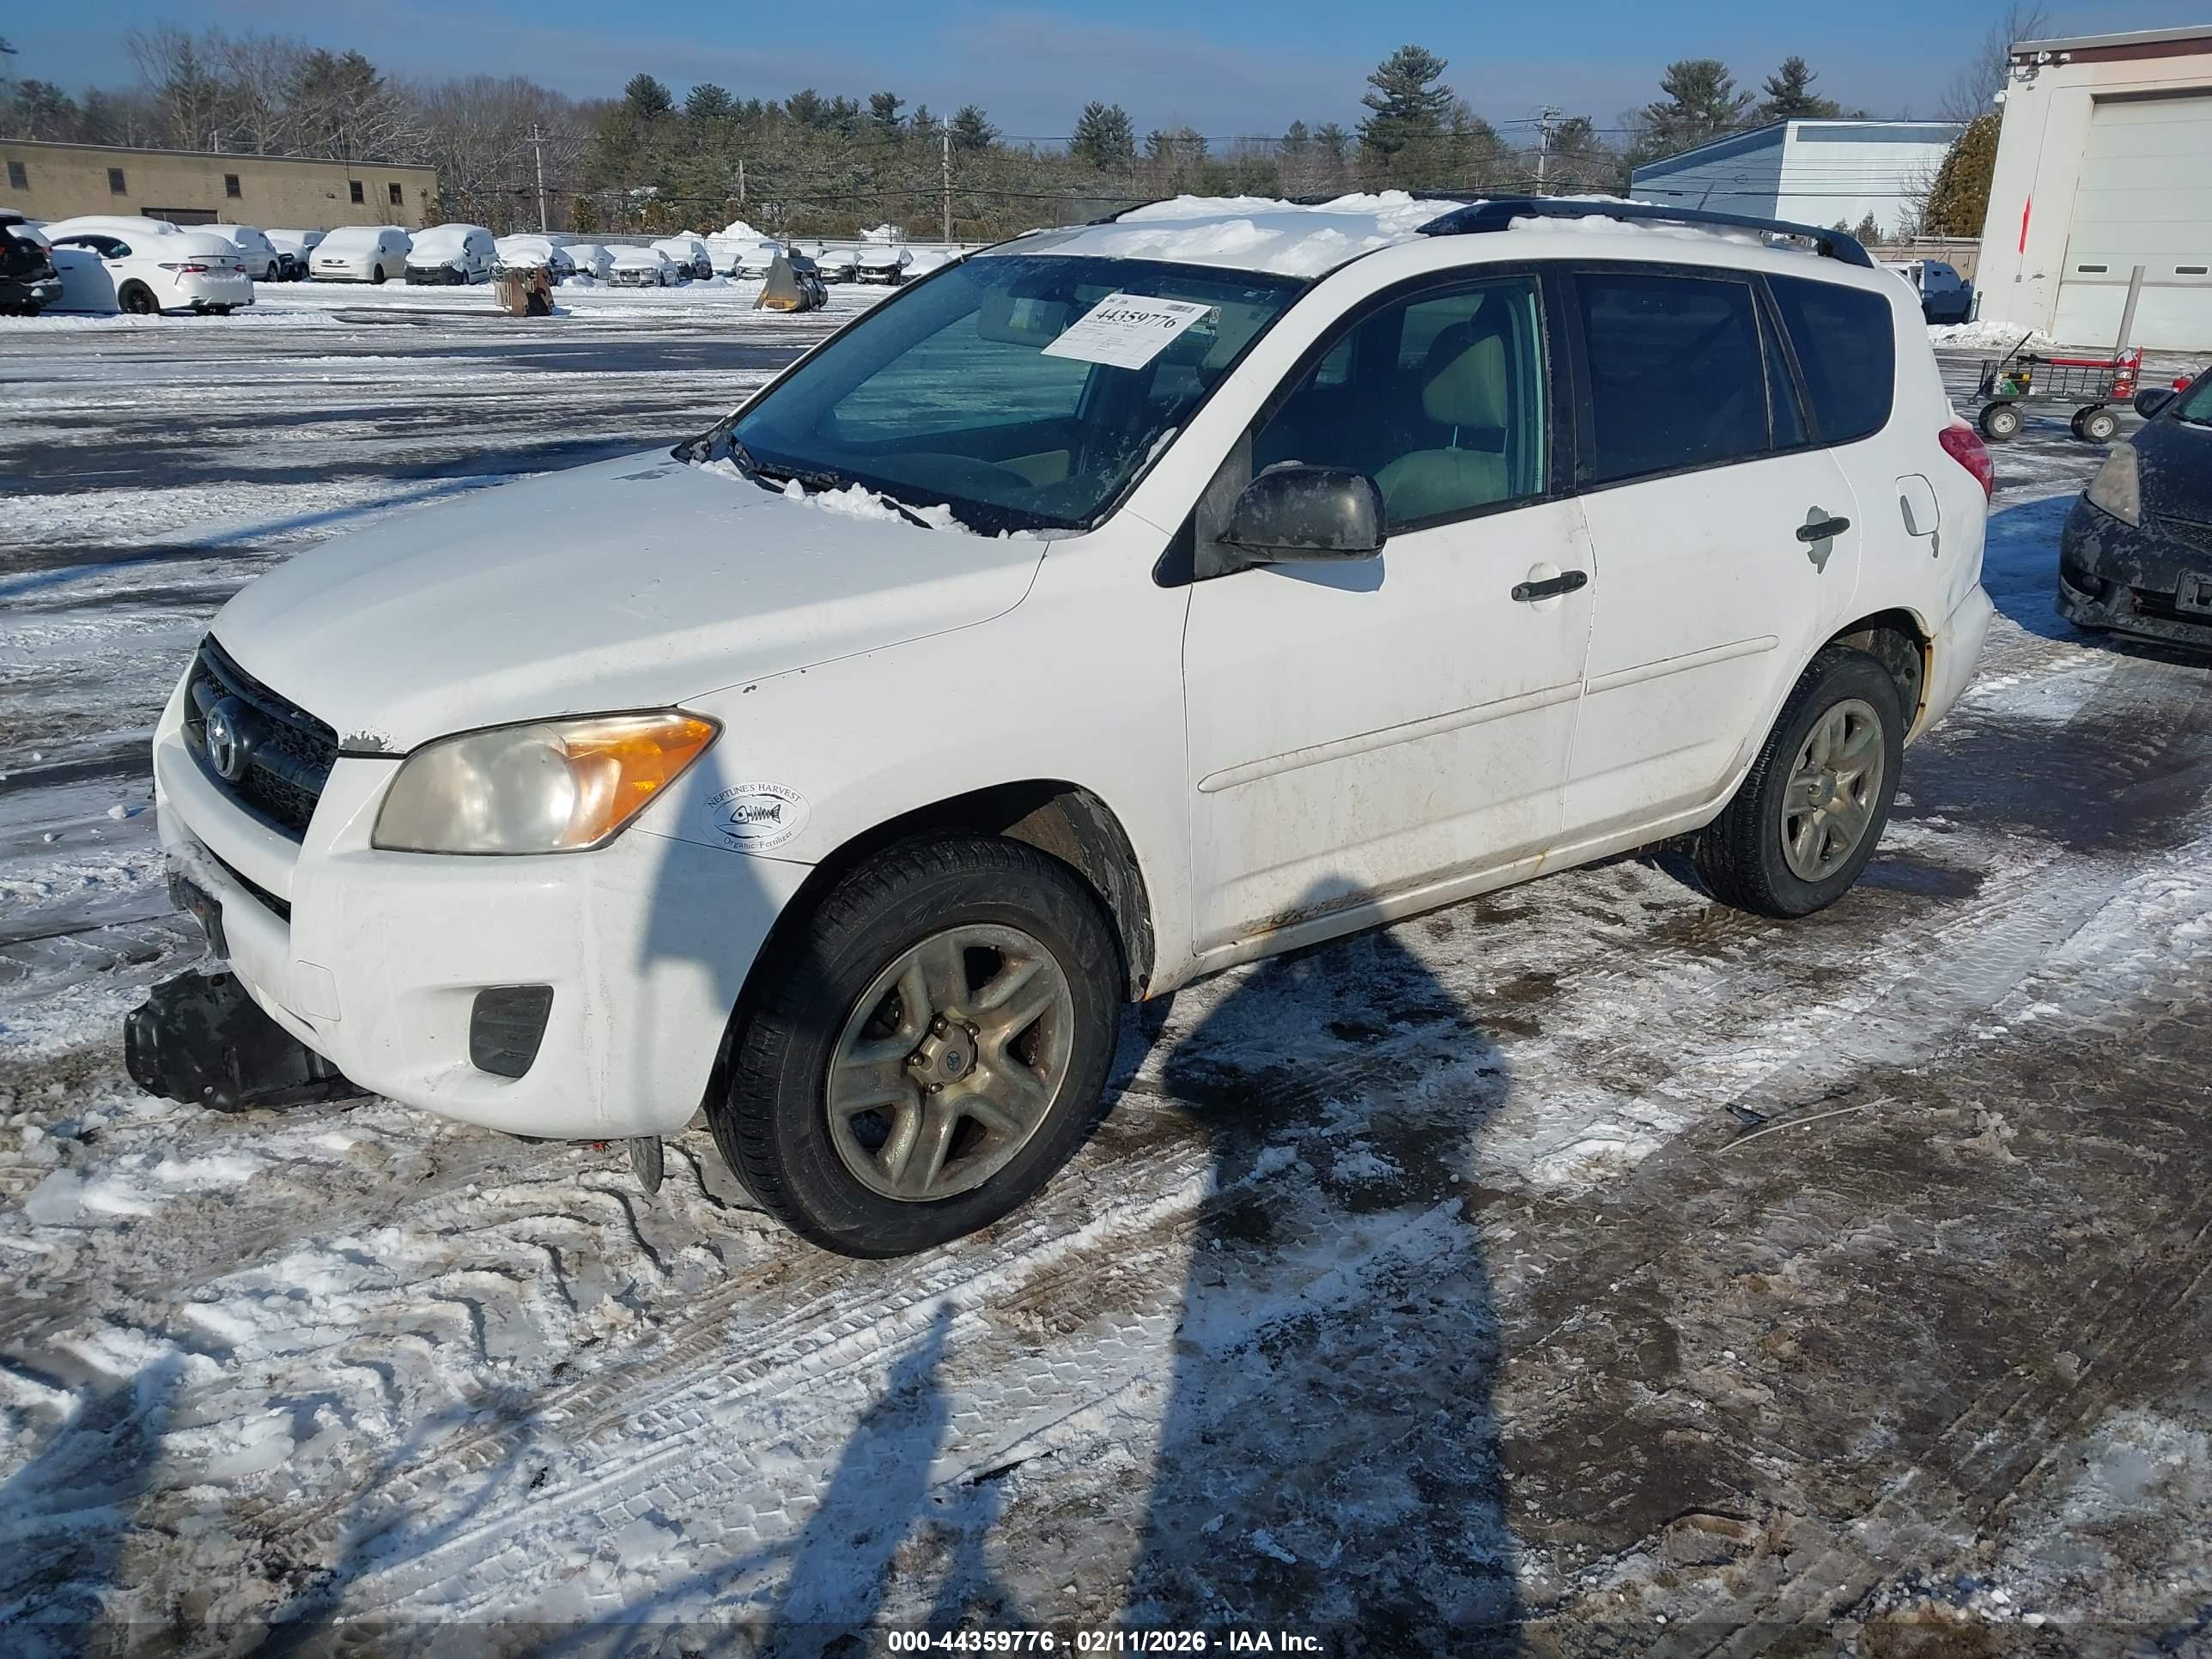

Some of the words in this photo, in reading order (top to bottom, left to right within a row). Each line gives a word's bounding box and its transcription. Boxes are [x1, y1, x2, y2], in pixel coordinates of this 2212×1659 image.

[1096, 307, 1181, 329] 44359776
[708, 784, 756, 809] NEPTUNE'S
[758, 783, 802, 802] HARVEST
[724, 837, 756, 849] Organic
[759, 830, 793, 848] Fertilizer
